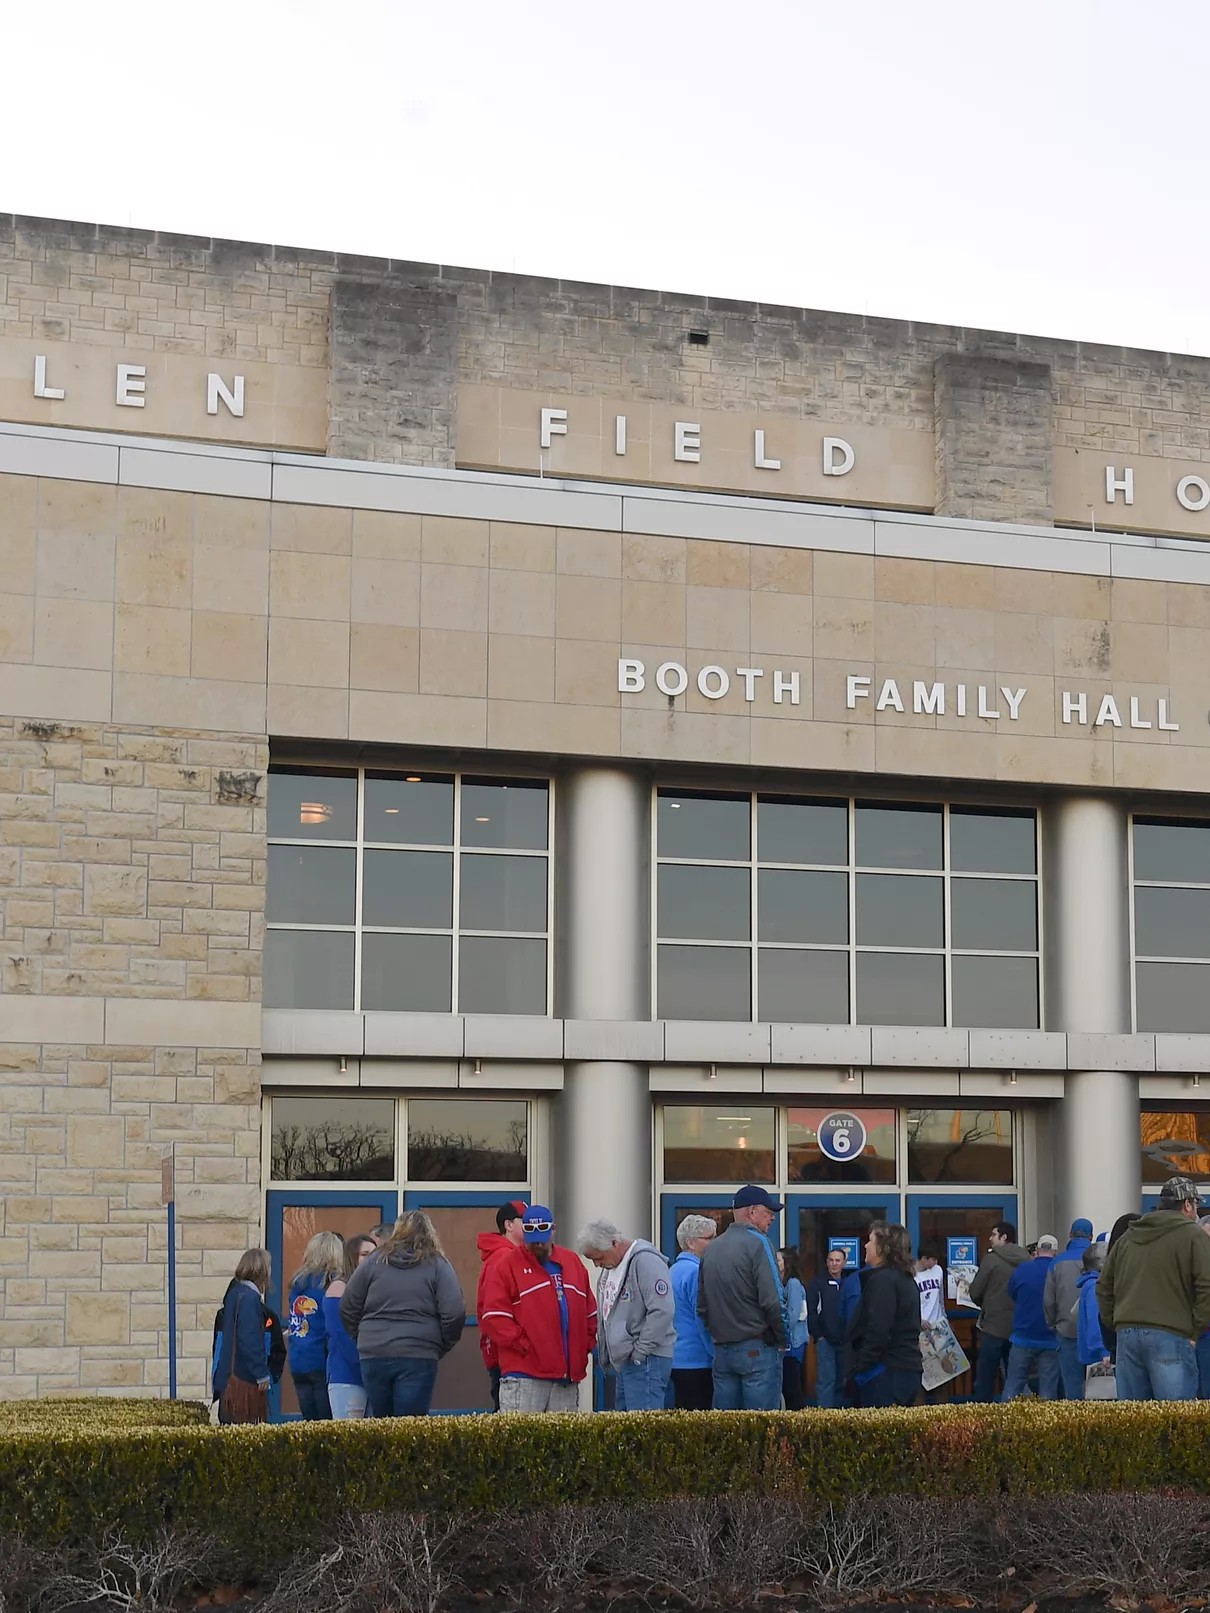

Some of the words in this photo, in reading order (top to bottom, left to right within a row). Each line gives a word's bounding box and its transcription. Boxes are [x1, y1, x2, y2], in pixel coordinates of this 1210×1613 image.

[33, 355, 246, 418] LEN
[540, 407, 857, 477] FIELD
[617, 658, 801, 706] BOOTH
[846, 674, 1027, 721] FAMILY
[1061, 690, 1180, 732] HALL
[829, 1119, 854, 1127] GATE
[832, 1128, 851, 1153] 6
[918, 1279, 940, 1292] ANSAS
